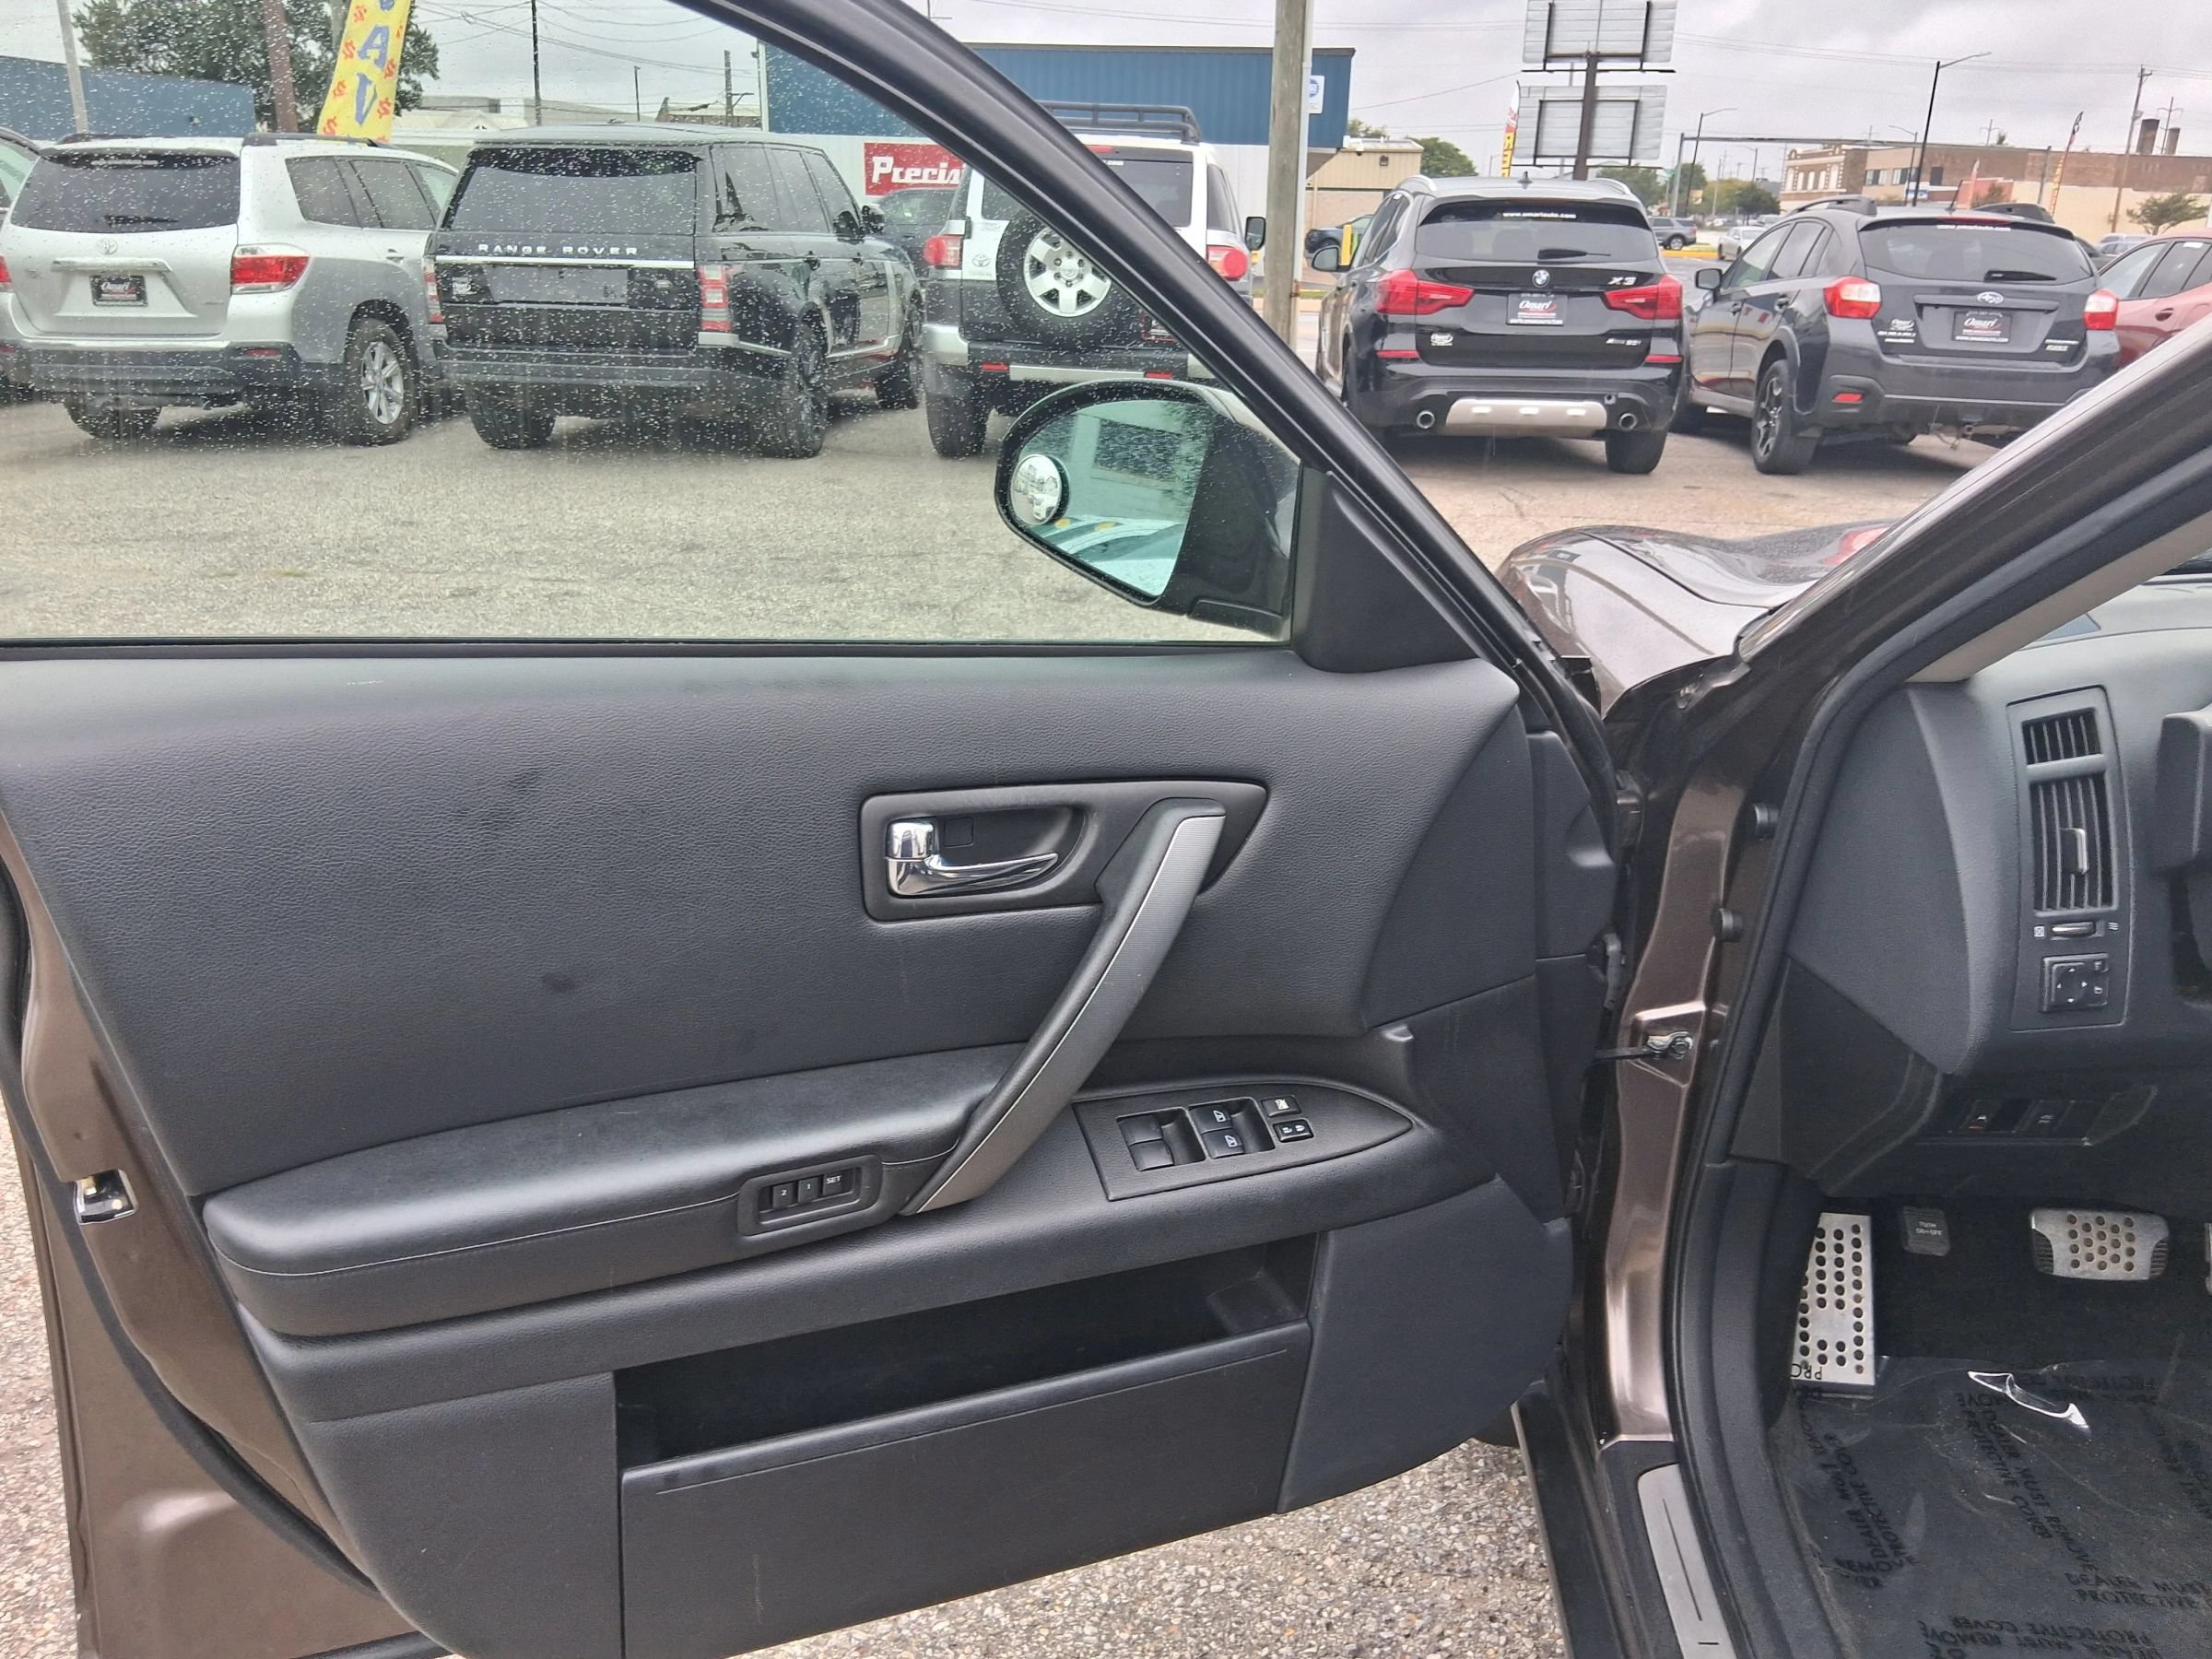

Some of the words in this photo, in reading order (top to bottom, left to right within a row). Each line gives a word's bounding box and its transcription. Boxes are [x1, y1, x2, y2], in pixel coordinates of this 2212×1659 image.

[872, 156, 966, 183] Precis
[478, 243, 547, 254] RANGE
[562, 246, 638, 255] ROVER
[1607, 276, 1637, 286] X3
